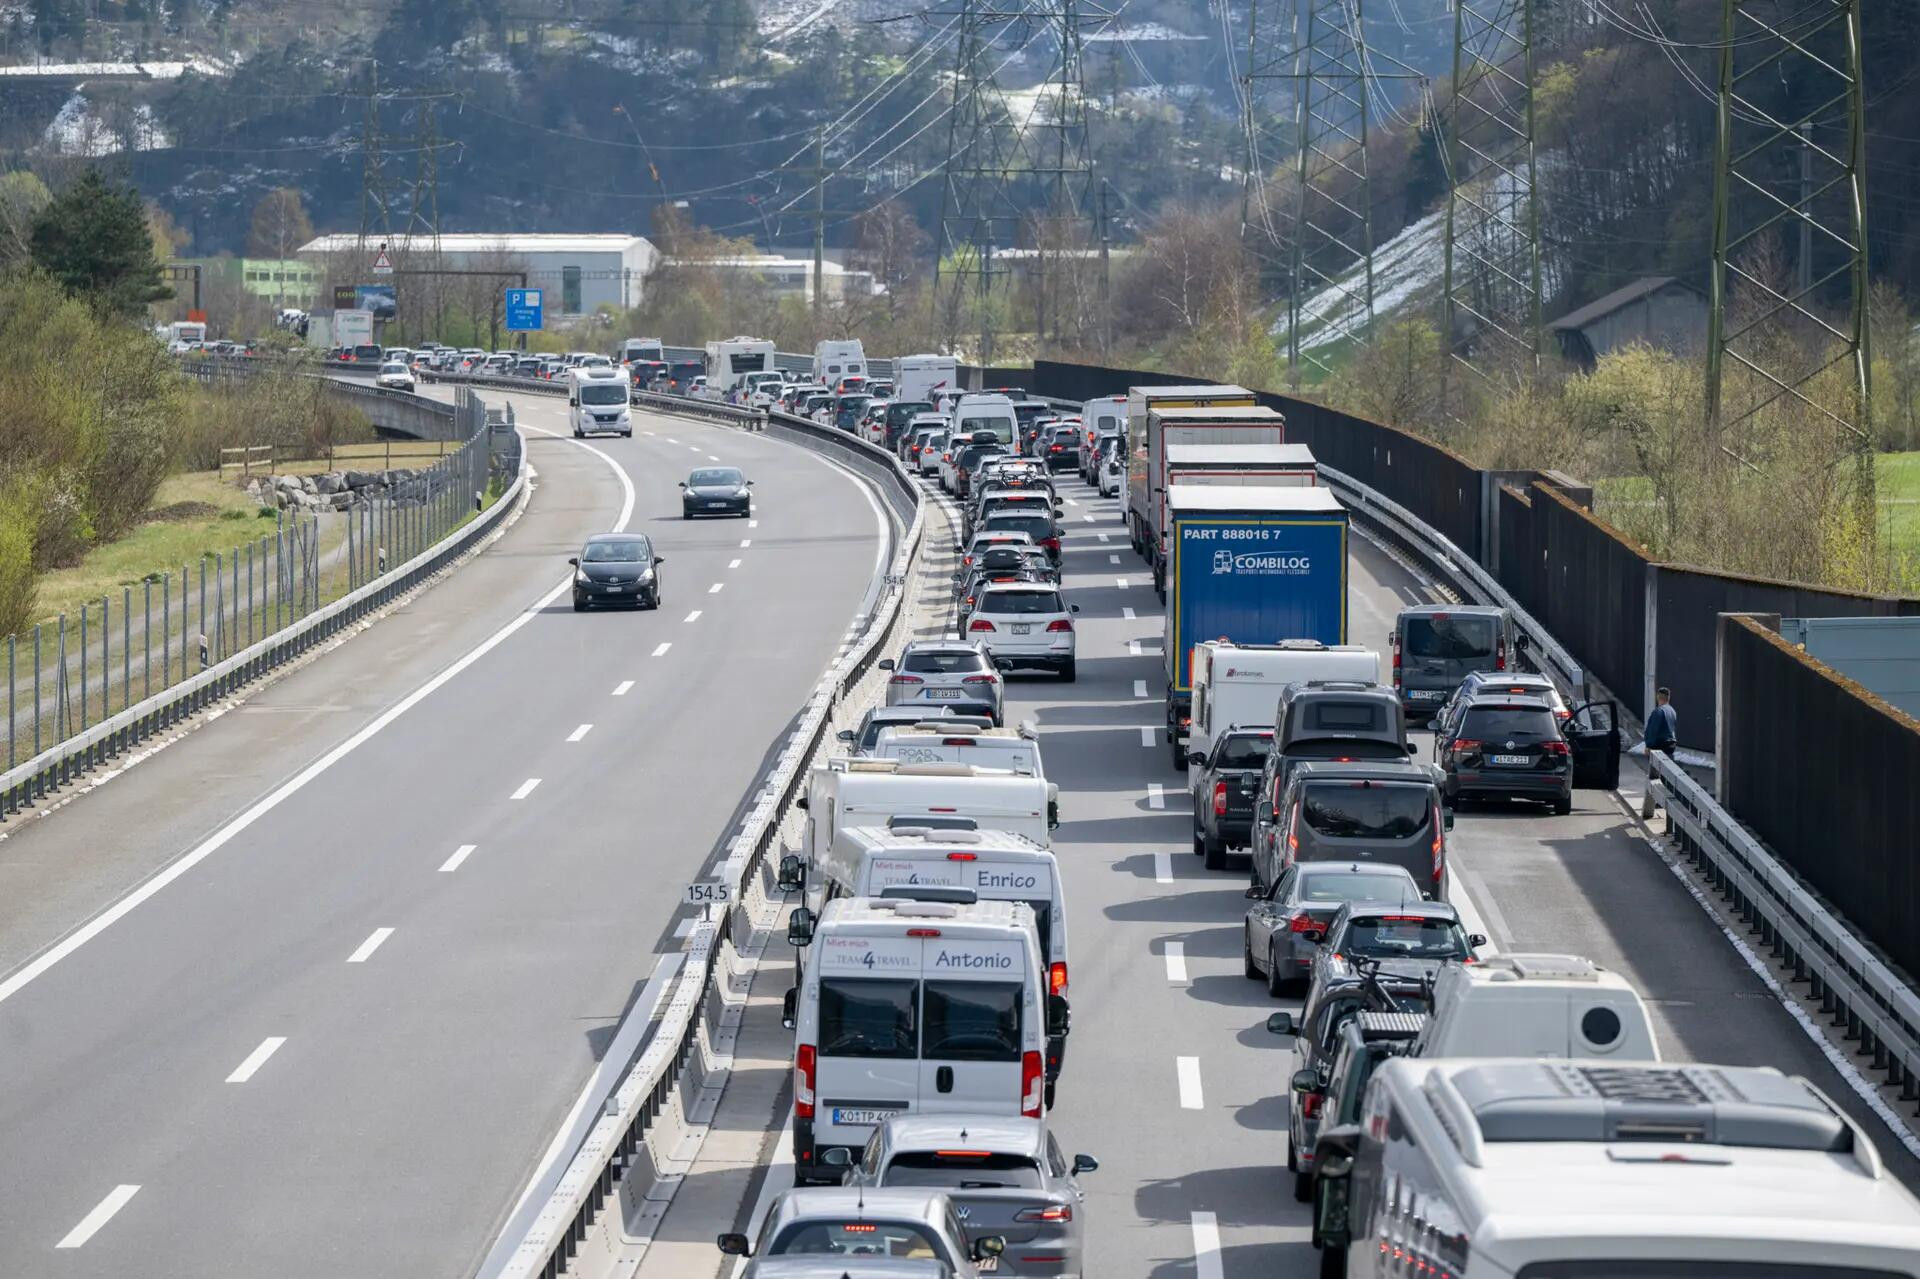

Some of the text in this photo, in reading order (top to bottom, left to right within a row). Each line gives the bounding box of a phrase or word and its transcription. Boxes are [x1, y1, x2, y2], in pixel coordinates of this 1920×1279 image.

[512, 293, 521, 305] P
[1183, 529, 1281, 540] PART 888016 7
[1235, 557, 1310, 569] COMBILOG
[882, 575, 905, 585] 154.6
[898, 748, 933, 757] ROAD
[977, 870, 1036, 888] Enrico
[688, 885, 728, 900] 154.5
[935, 950, 1012, 969] Antonio
